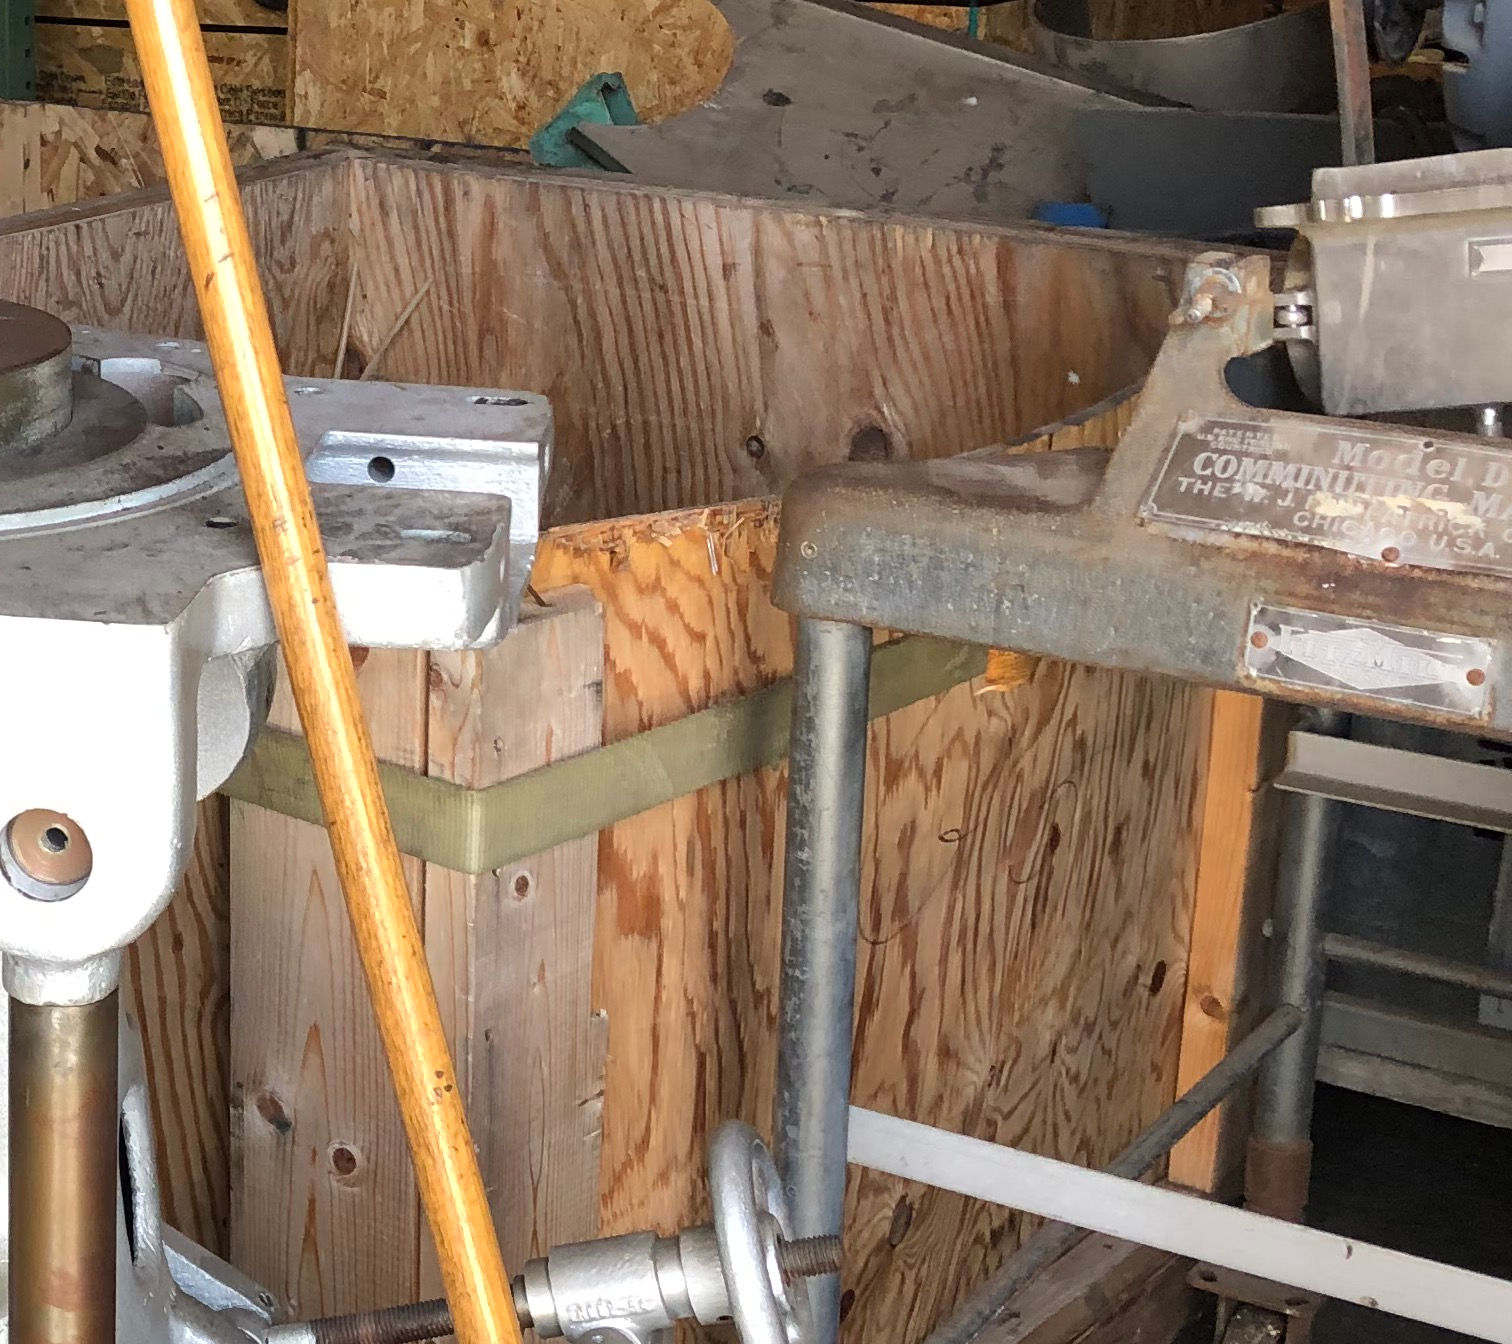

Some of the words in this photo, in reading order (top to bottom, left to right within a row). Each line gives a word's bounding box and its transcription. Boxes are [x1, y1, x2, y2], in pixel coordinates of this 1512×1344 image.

[1331, 440, 1467, 482] Model
[1177, 476, 1229, 498] THE
[1293, 511, 1417, 548] CHICAGO
[1430, 535, 1500, 559] U.S.A.
